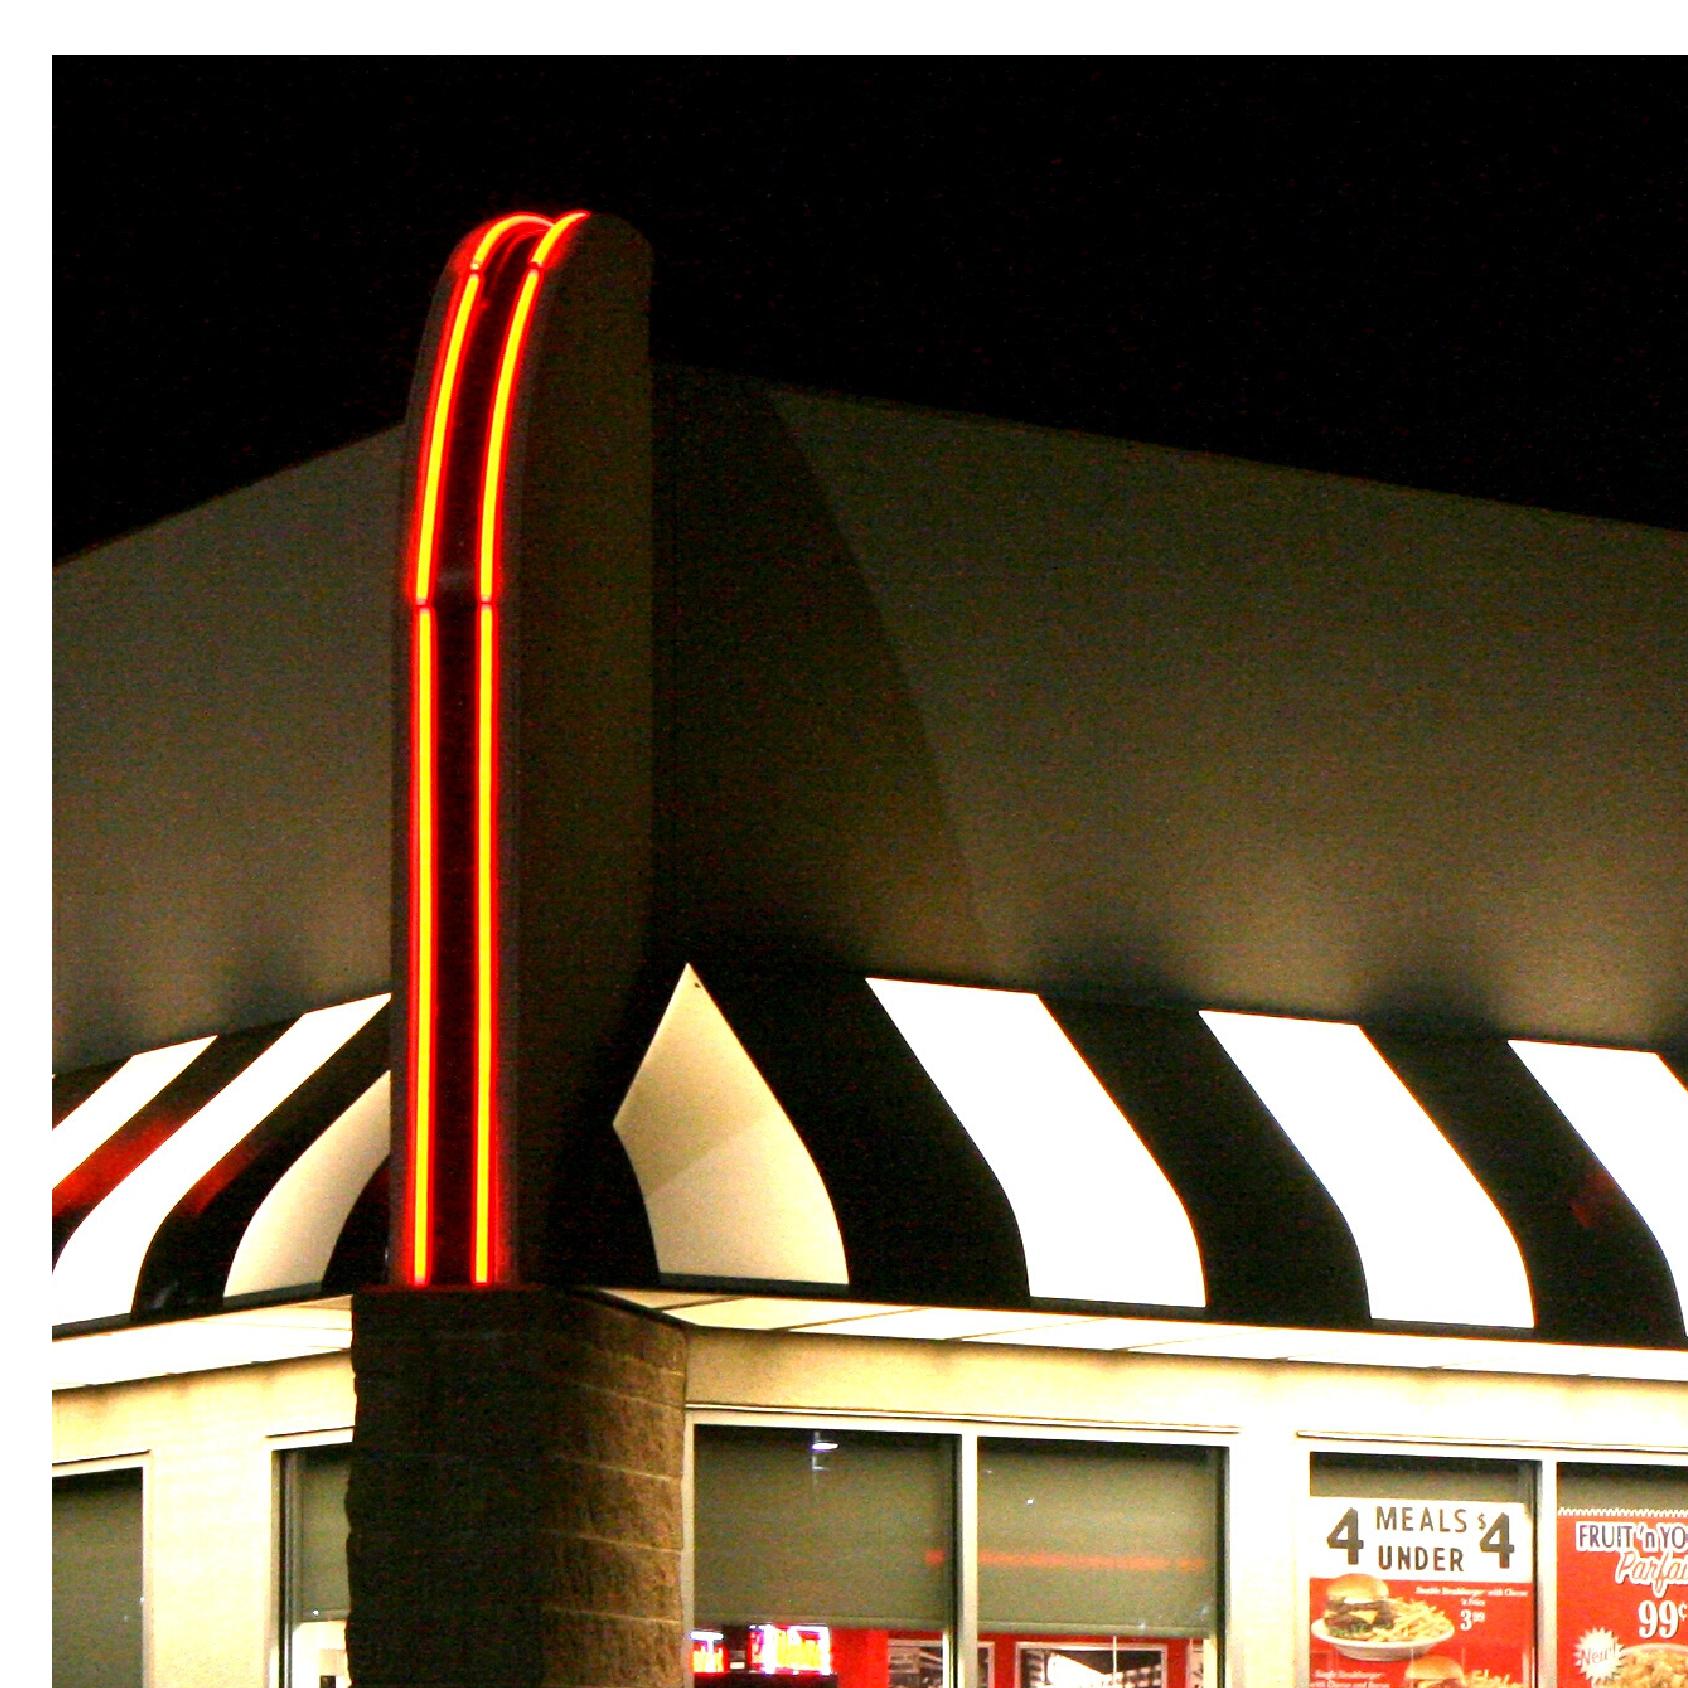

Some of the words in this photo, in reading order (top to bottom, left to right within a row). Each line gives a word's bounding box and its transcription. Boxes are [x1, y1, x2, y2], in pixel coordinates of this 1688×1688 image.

[1326, 1506, 1365, 1566] 4
[1375, 1505, 1468, 1533] MEALS
[1578, 1524, 1634, 1549] FRUIT
[1377, 1544, 1465, 1572] UNDER
